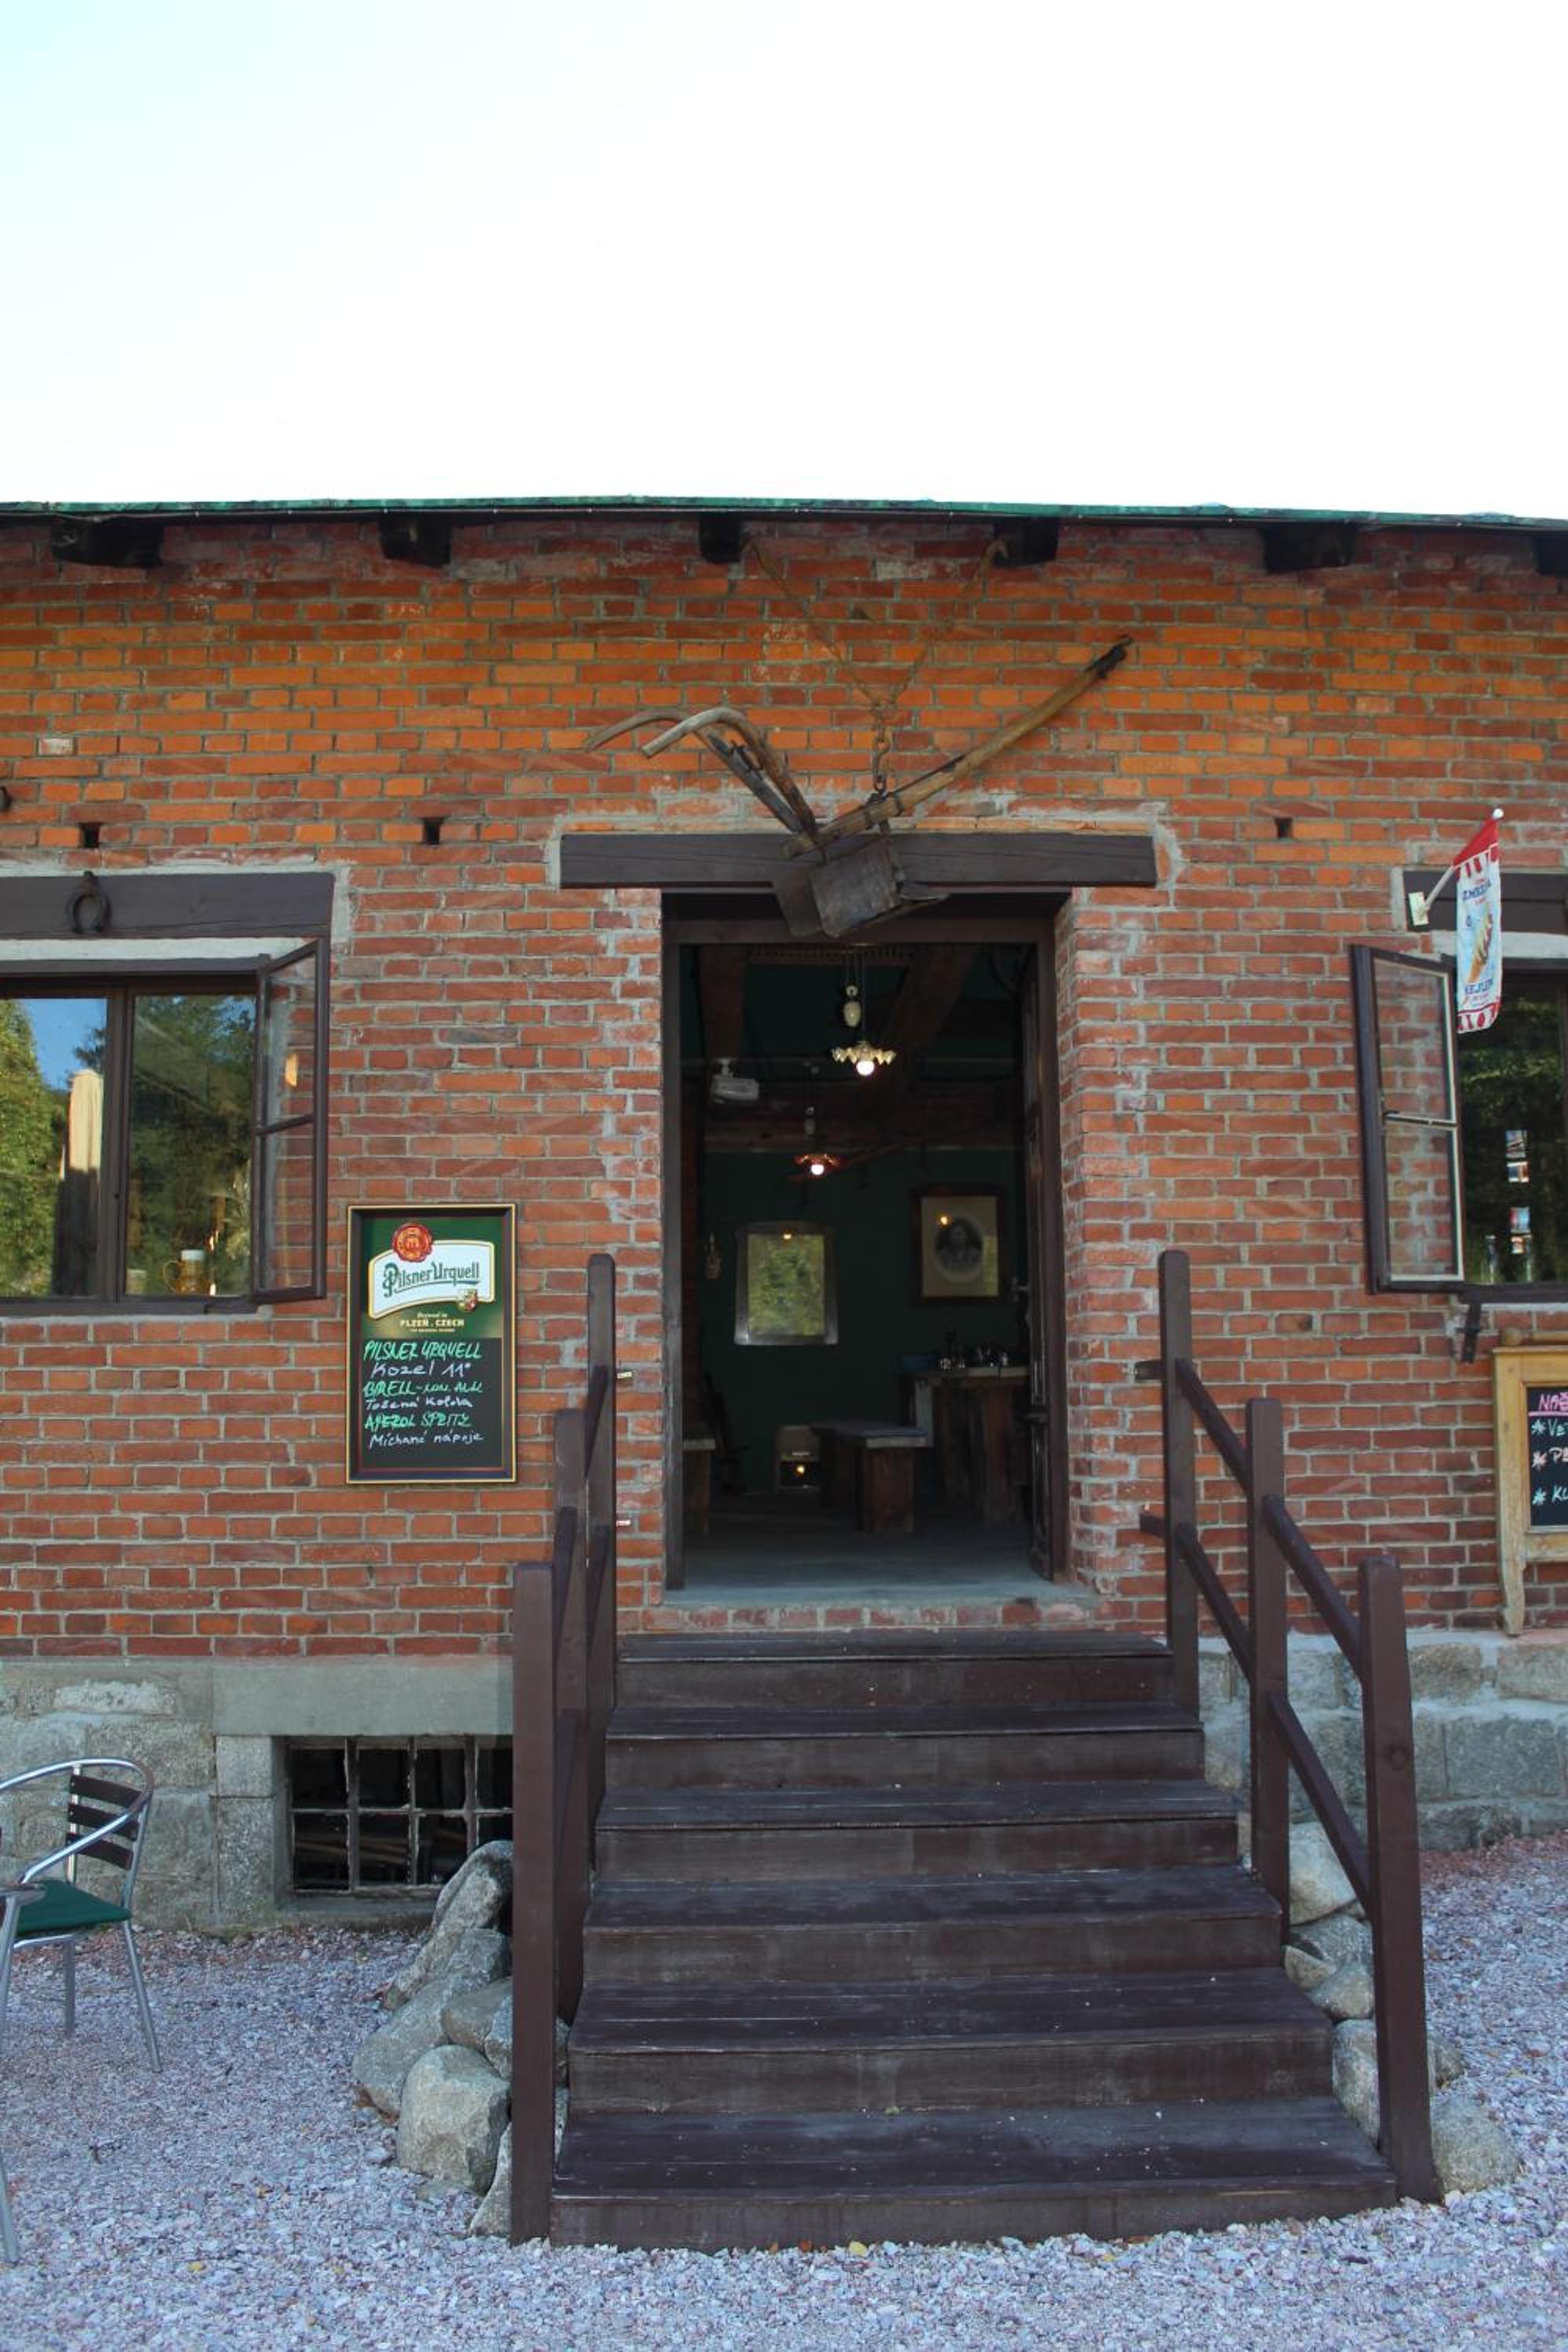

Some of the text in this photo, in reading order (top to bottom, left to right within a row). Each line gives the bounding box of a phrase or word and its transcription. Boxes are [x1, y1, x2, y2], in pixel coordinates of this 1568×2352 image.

[383, 1261, 480, 1298] Pilsner Urquell
[364, 1339, 483, 1361] PILSNER URQUELL
[371, 1360, 434, 1378] Kozel
